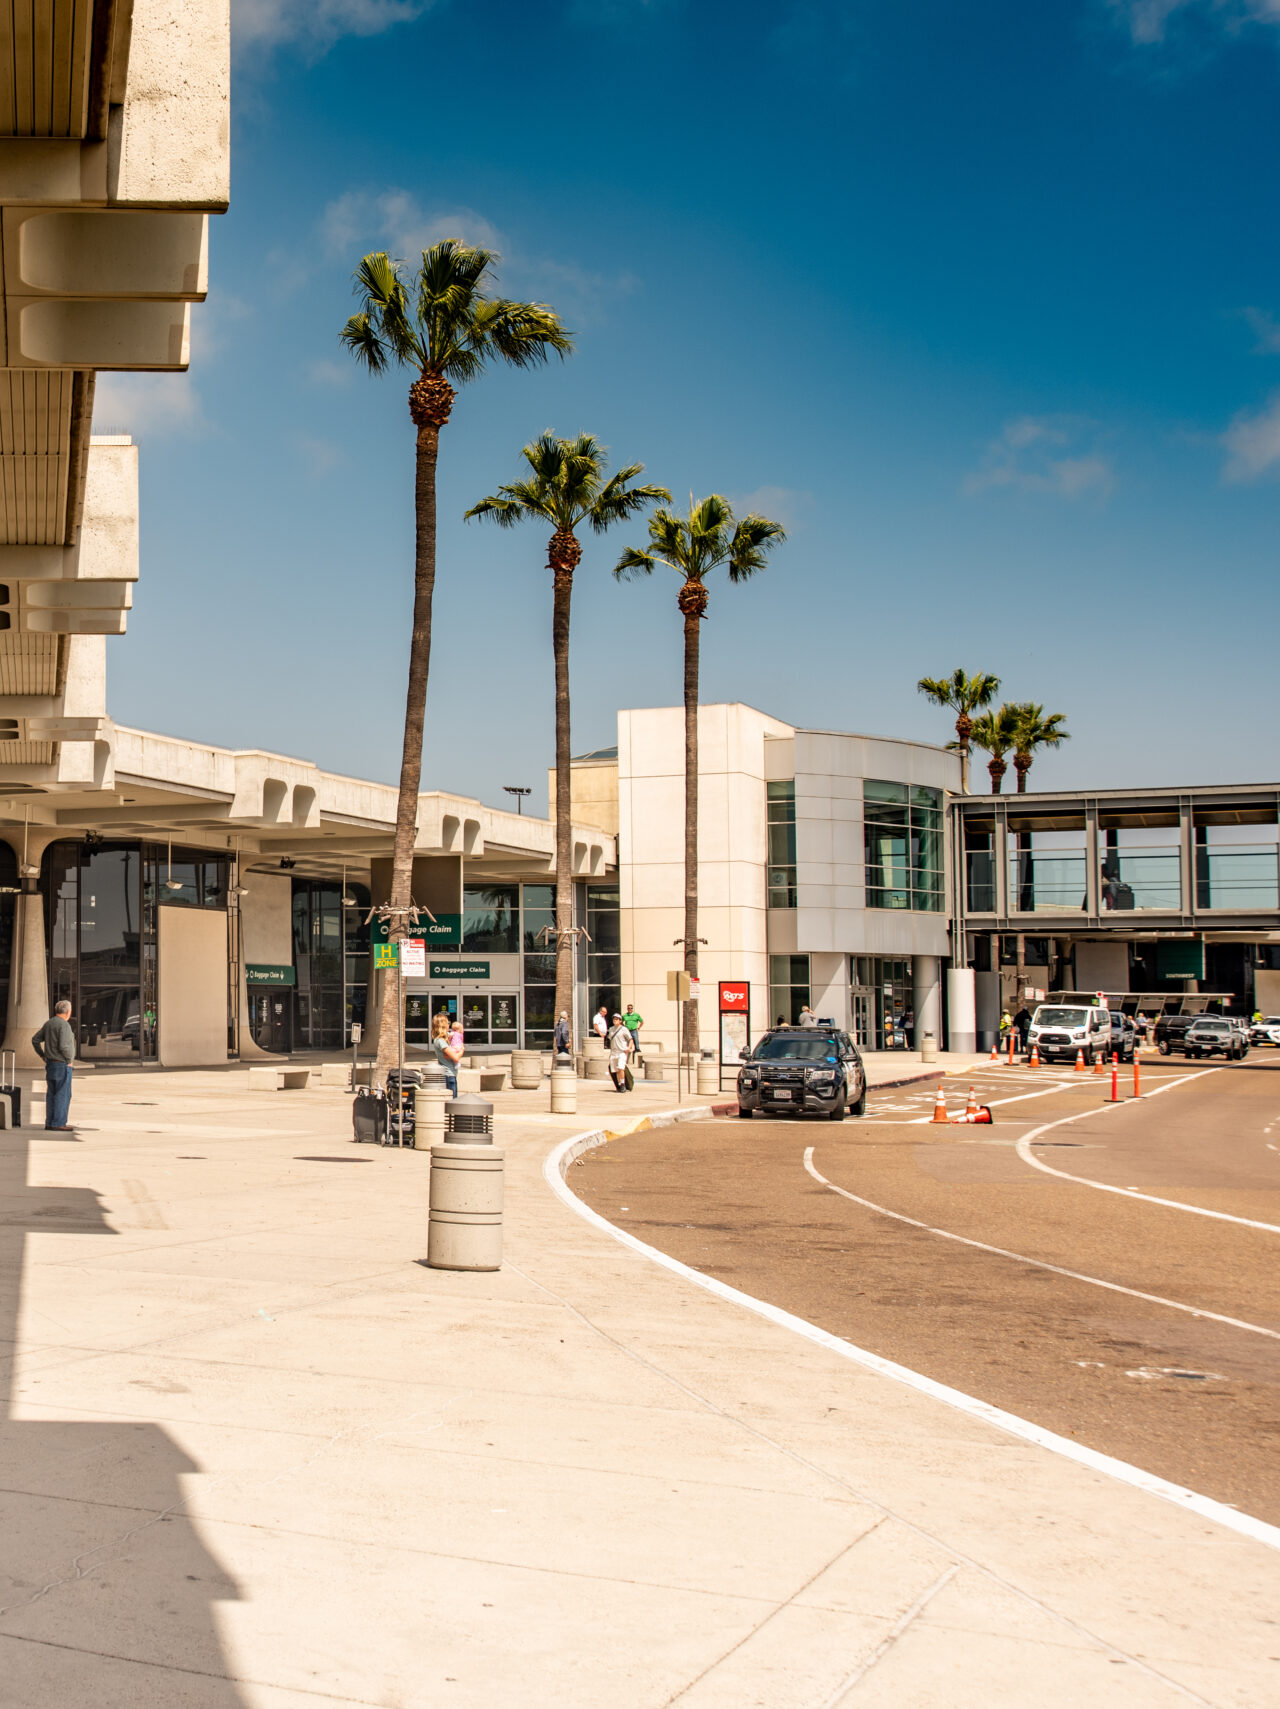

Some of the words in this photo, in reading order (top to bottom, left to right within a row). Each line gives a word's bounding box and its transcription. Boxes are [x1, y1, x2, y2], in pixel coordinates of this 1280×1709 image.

[429, 925, 452, 933] Claim
[381, 945, 392, 958] H
[376, 959, 398, 968] ZONE
